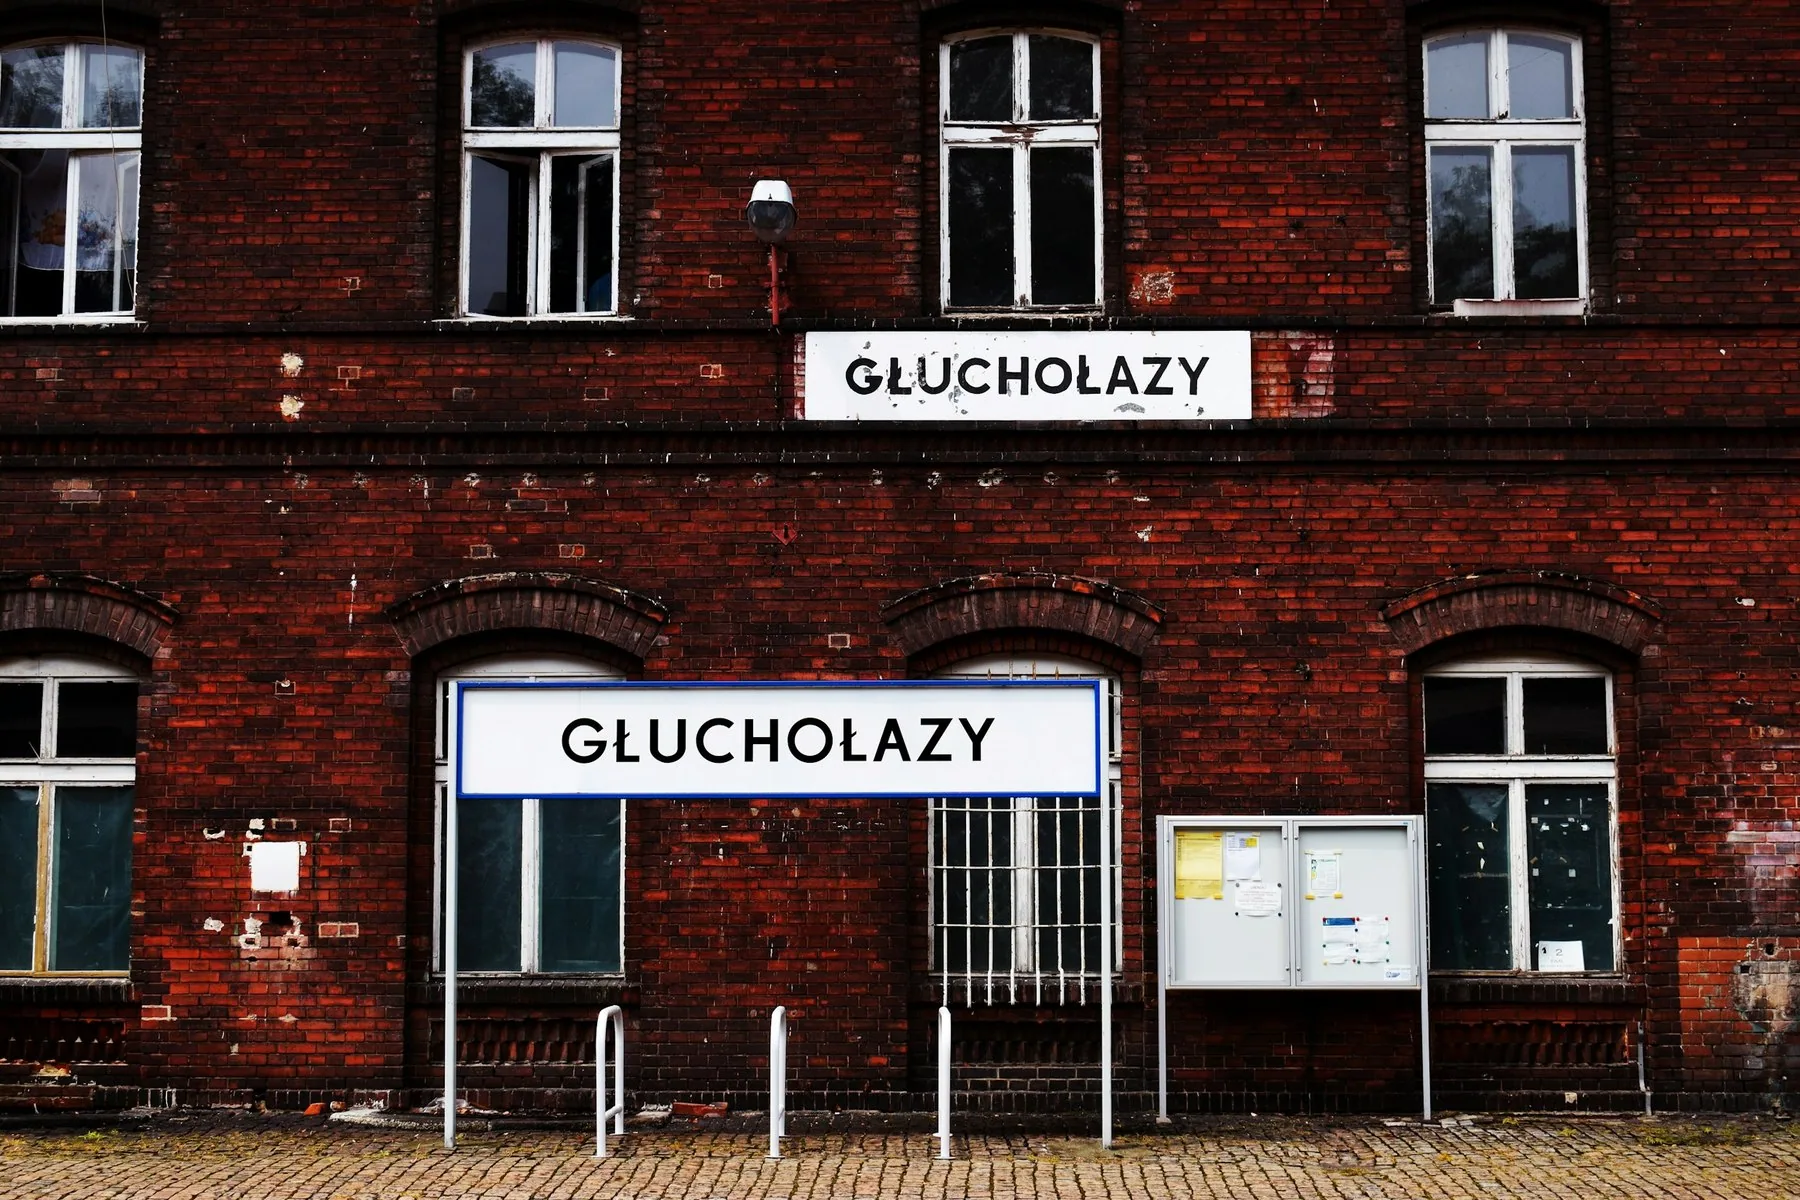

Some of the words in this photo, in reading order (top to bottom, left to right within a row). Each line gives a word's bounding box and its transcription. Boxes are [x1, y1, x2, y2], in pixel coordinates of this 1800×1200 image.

[846, 354, 1210, 396] GŁUCHOŁAZY
[562, 717, 995, 764] GŁUCHOŁAZY
[1555, 948, 1563, 957] 2
